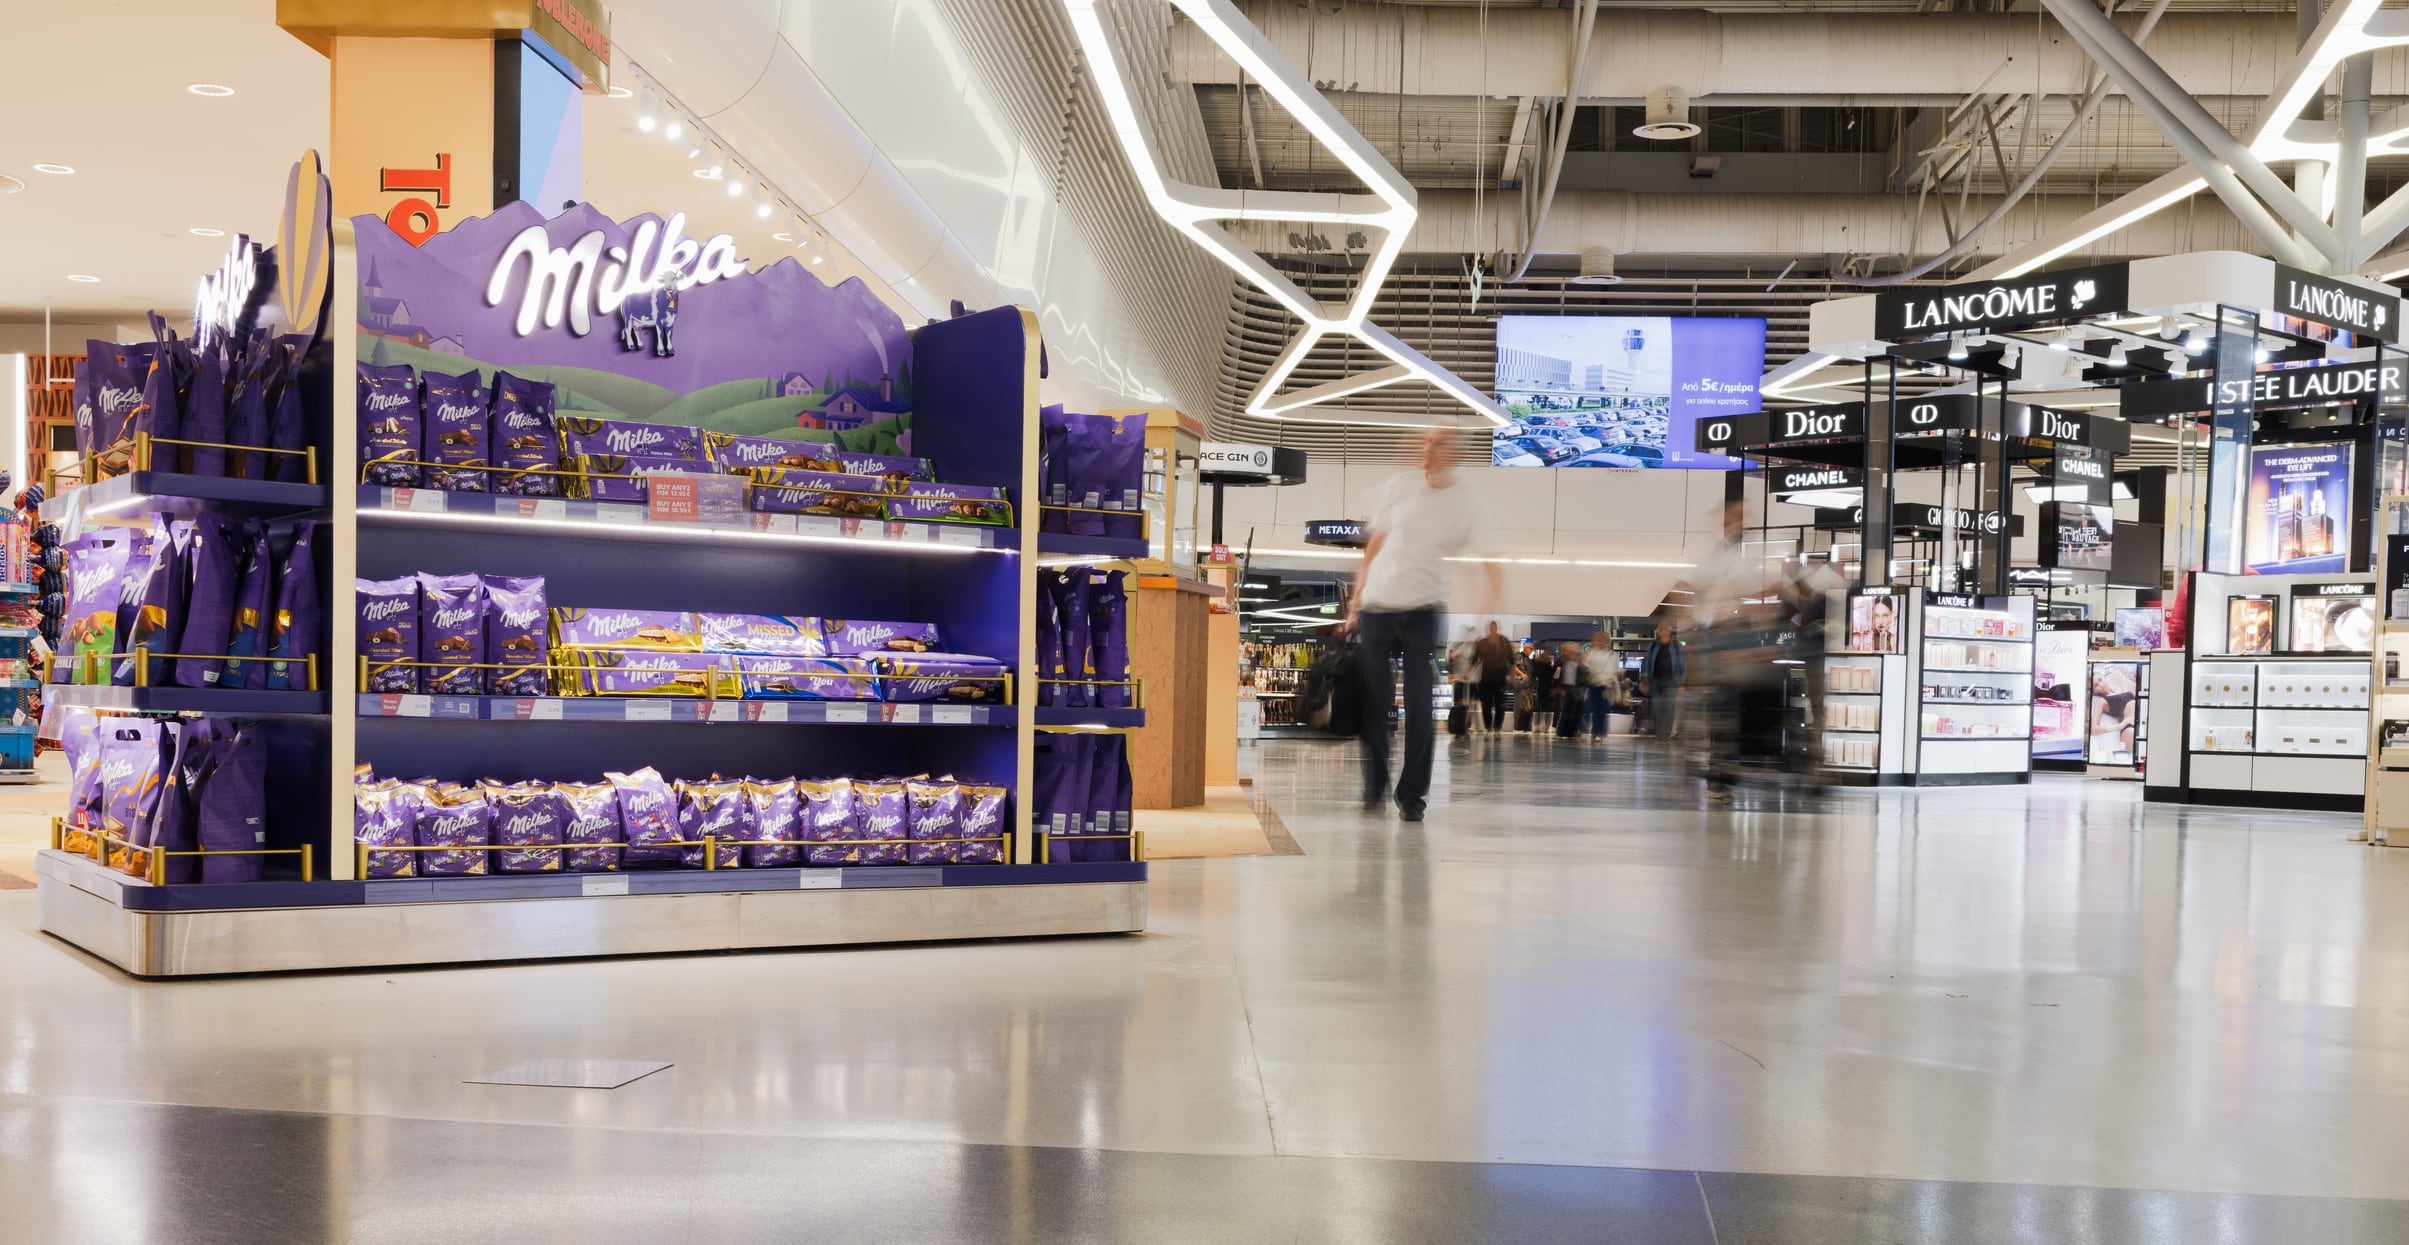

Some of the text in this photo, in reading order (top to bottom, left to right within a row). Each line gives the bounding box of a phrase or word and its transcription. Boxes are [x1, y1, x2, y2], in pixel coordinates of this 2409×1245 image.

[487, 211, 751, 336] Milka
[1904, 284, 2056, 329] LANCÔME
[2290, 281, 2369, 328] LANCÔME
[1682, 382, 1698, 391] Από
[2288, 367, 2400, 399] LAUDER
[365, 392, 411, 410] Milka
[1697, 397, 1715, 405] online
[437, 403, 480, 421] Milka
[504, 411, 542, 429] Milka
[1784, 410, 1846, 438] Dior
[2040, 410, 2081, 441] Dior
[606, 427, 665, 452] Milka
[737, 443, 787, 462] Milka
[1227, 453, 1249, 462] GIN
[843, 458, 886, 475] Milka
[2062, 459, 2104, 478] CHANEL
[2300, 463, 2313, 471] LIFT
[1785, 471, 1847, 487] CHANEL
[777, 479, 833, 503] Milka
[1318, 525, 1360, 535] METAXA
[2319, 585, 2365, 595] LANCÔME
[362, 598, 410, 620] Milka
[1937, 595, 1968, 607] LANCÔME
[432, 608, 475, 628] Milka
[500, 609, 542, 628] Milka
[587, 613, 643, 637] Milka
[2036, 622, 2055, 631] Dior
[746, 624, 796, 637] MISSED
[847, 624, 894, 646] Milka
[624, 656, 680, 684] Milka
[752, 660, 794, 679] Milka
[810, 676, 834, 690] You
[629, 792, 665, 813] Milka
[359, 818, 404, 841] Milka
[433, 808, 479, 836] Milka
[507, 812, 553, 835] Milka
[566, 817, 612, 838] Milka
[759, 813, 795, 835] Milka
[866, 815, 902, 833] Milka
[916, 815, 954, 834] Milka
